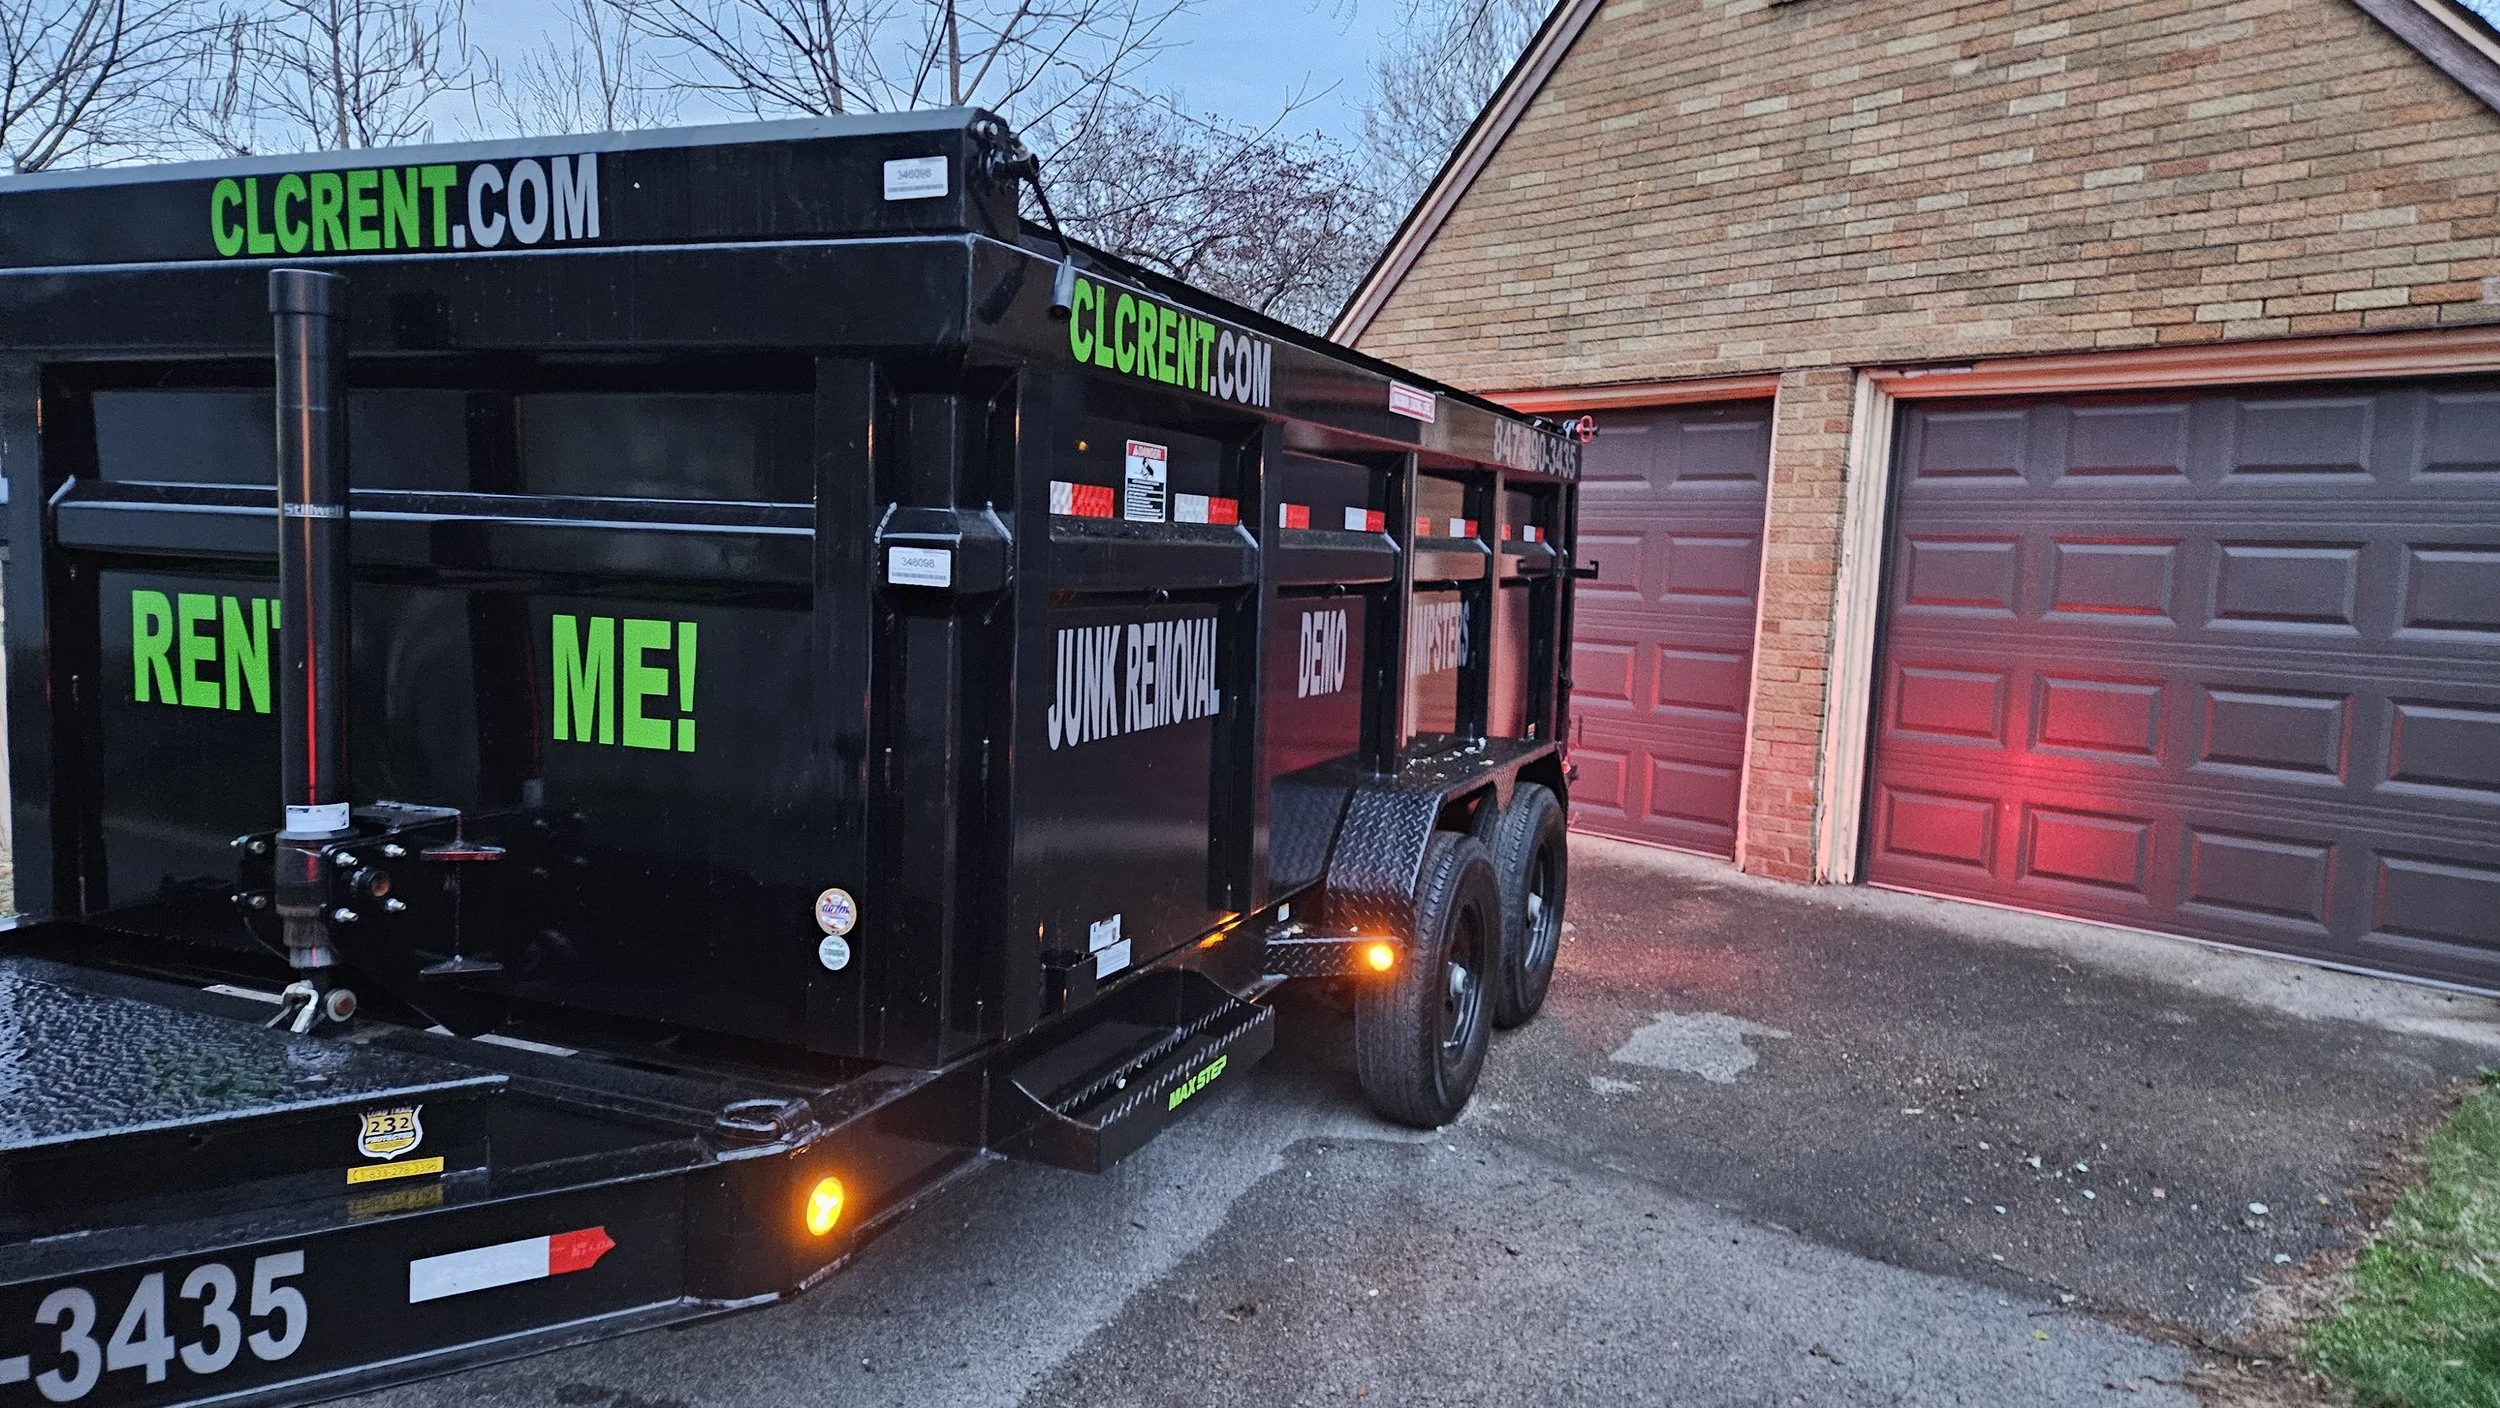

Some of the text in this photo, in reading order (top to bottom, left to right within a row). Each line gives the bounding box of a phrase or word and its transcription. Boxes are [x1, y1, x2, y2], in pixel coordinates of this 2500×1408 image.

[211, 153, 600, 257] CLCRENT.COM
[1070, 279, 1271, 407] CLCRENT.COM
[284, 503, 344, 517] Stillwell
[132, 590, 697, 752] REN ME!
[1048, 616, 1220, 751] JUNK REMOVAL
[1299, 608, 1347, 699] DEMO
[371, 1117, 409, 1133] 232
[1168, 1054, 1227, 1111] MAX STEP
[0, 1250, 308, 1402] -3435
